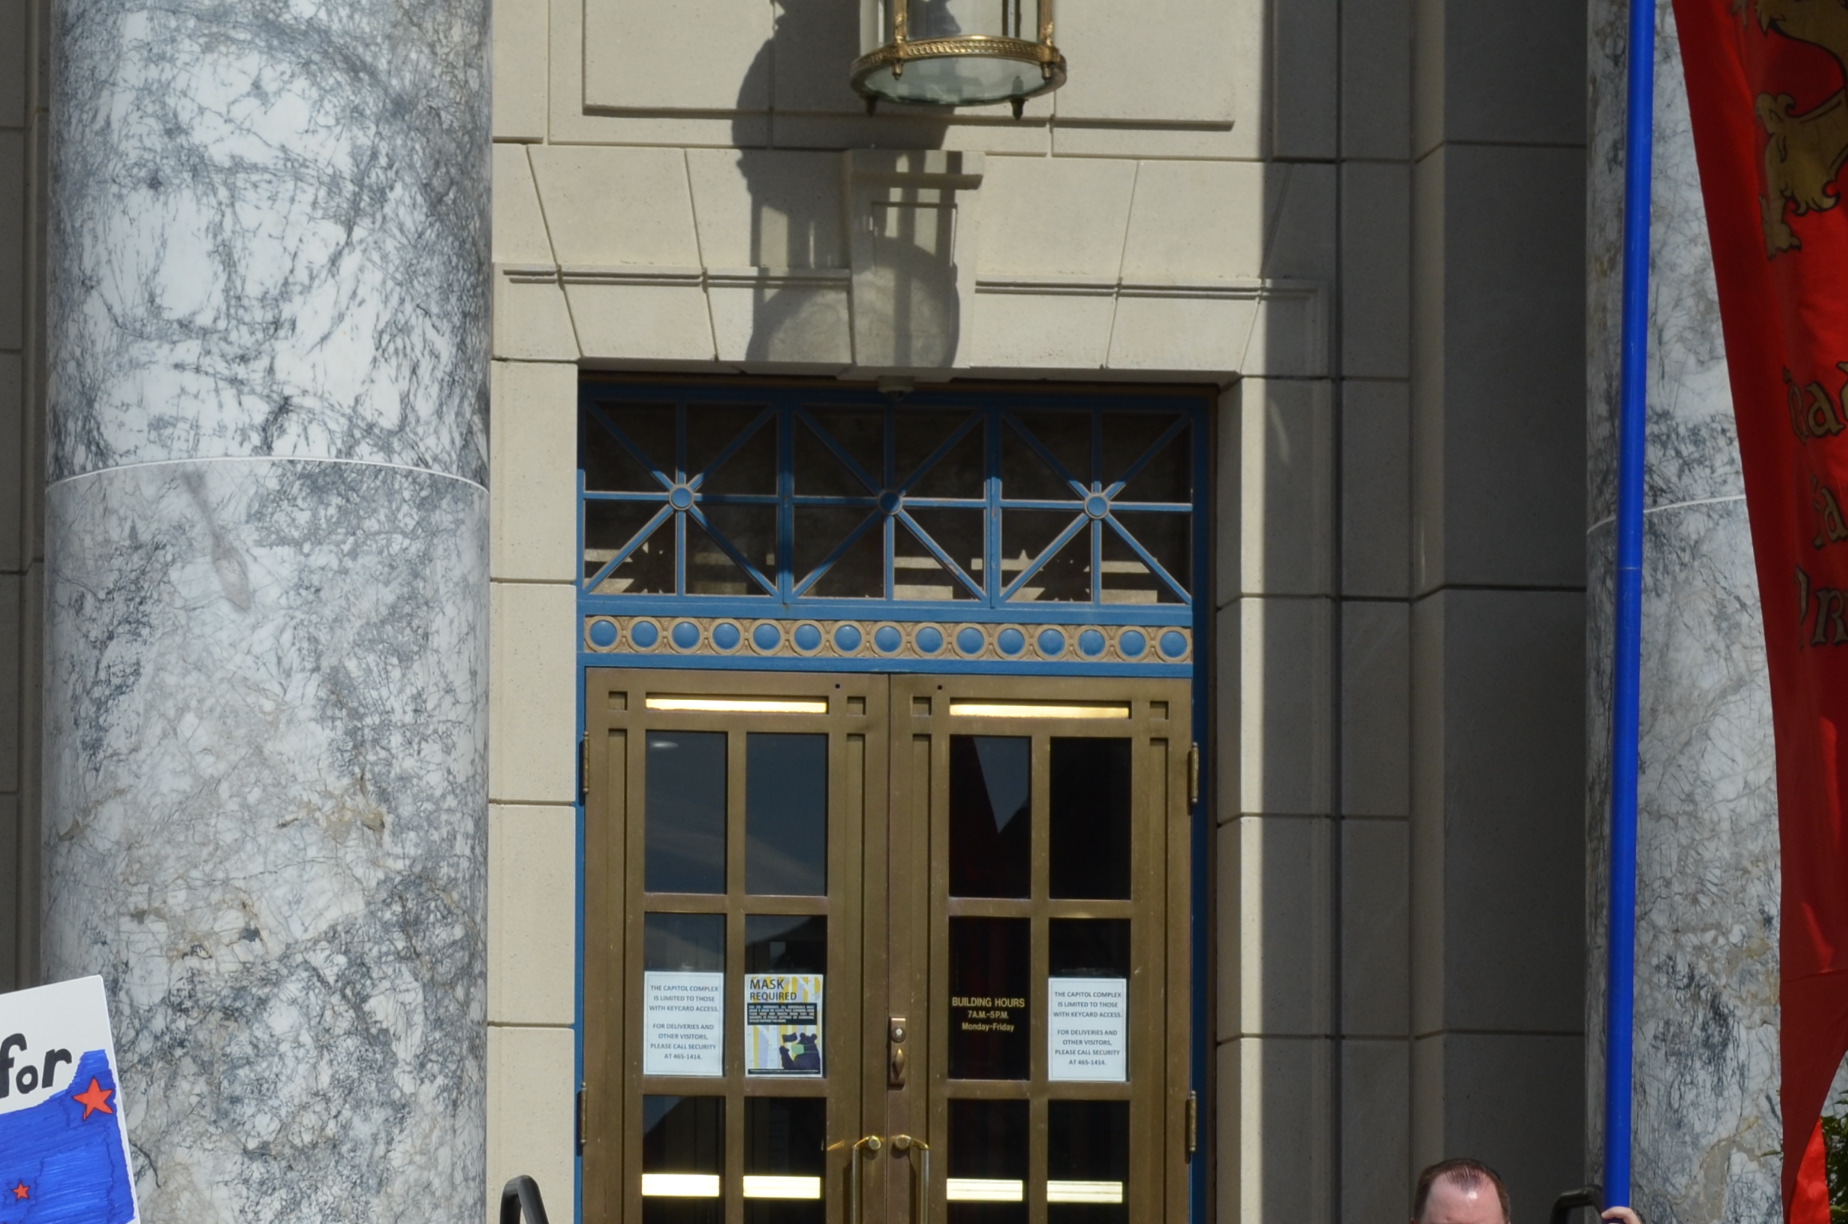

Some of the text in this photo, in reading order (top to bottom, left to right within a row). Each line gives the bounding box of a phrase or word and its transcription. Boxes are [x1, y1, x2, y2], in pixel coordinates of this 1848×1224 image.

[750, 978, 784, 990] MASK
[750, 992, 797, 1001] REQUIRED
[952, 997, 1025, 1008] BUILDING HOURS
